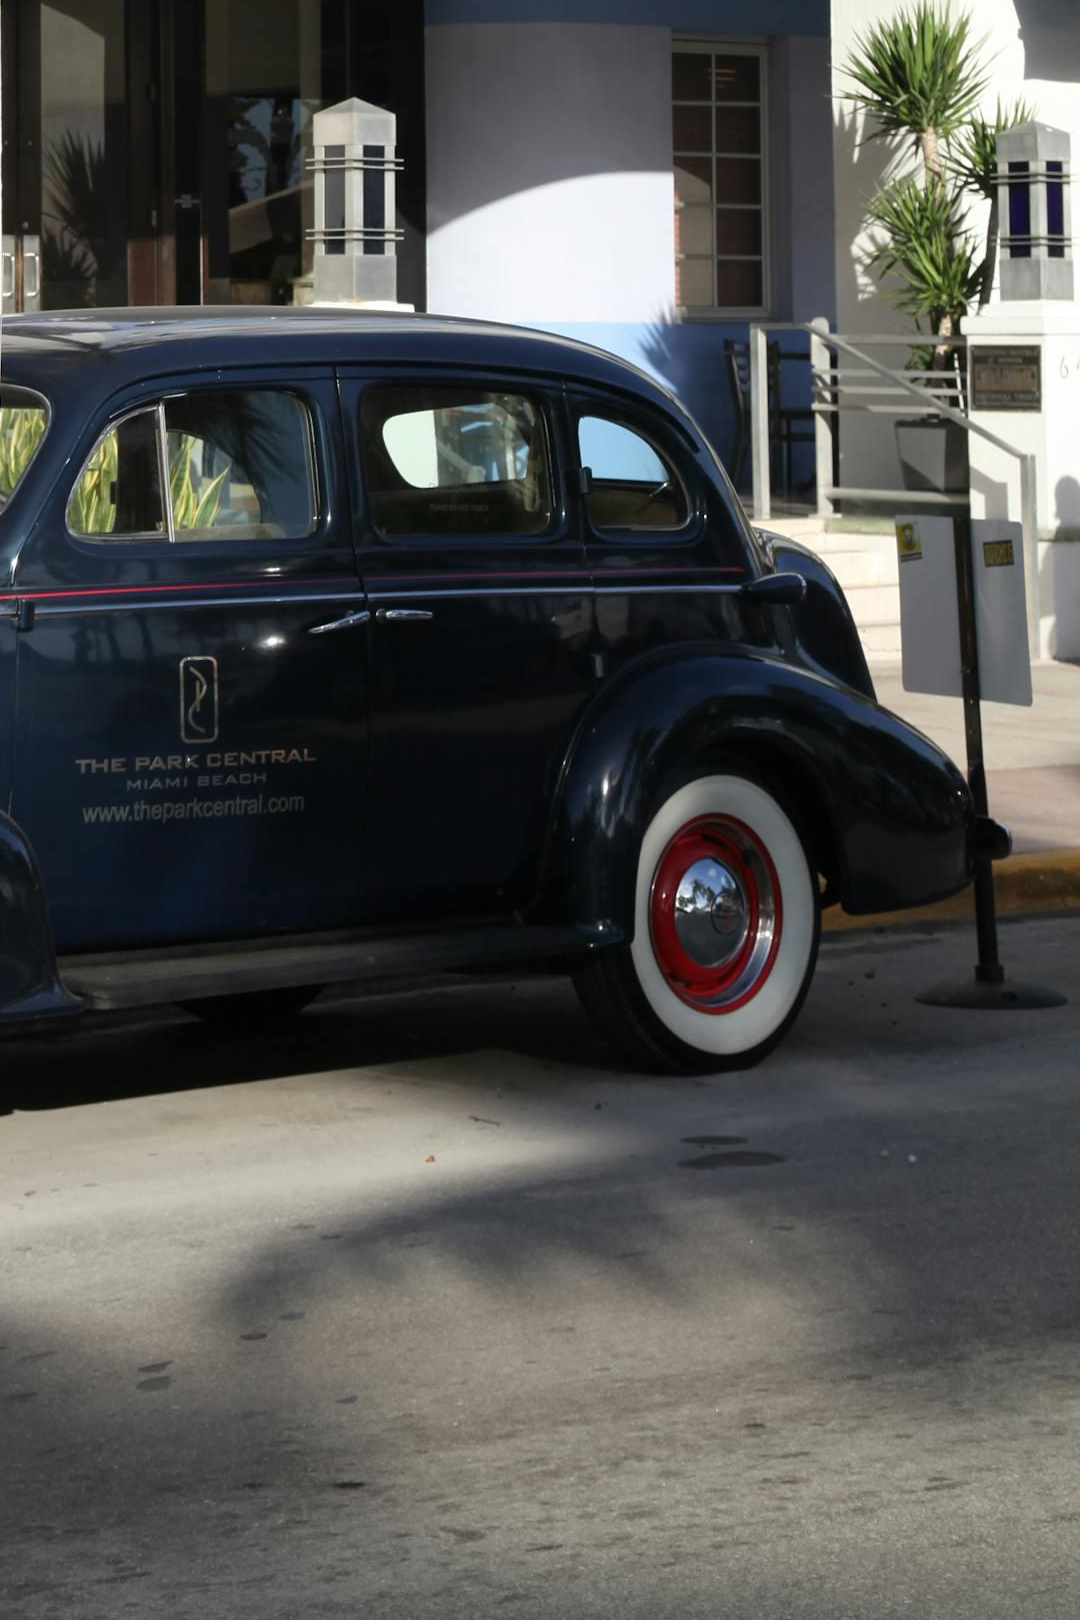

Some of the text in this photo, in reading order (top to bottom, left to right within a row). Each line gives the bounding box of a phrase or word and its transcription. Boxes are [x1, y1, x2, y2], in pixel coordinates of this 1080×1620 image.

[75, 748, 316, 774] THE PARK CENTRAL
[126, 772, 267, 791] MIAMI BEACH
[82, 794, 305, 823] www.theparkcentral.com
